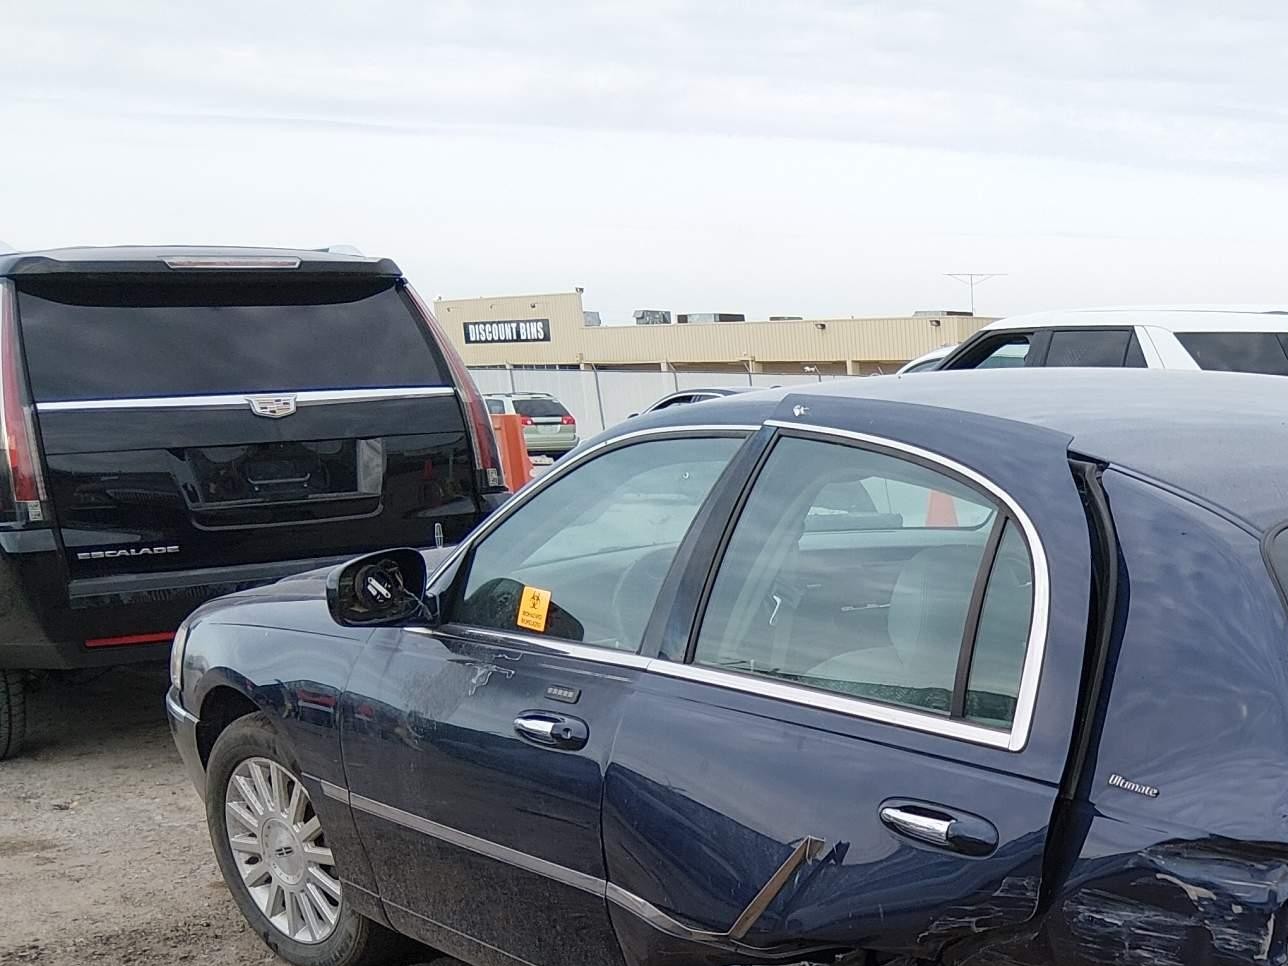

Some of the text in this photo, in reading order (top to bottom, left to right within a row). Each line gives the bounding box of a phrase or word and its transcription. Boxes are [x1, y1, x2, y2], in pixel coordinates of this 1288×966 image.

[468, 321, 544, 341] DISCOUNT BINS
[77, 545, 180, 560] ESCALADE
[1108, 773, 1158, 797] Ultimate
